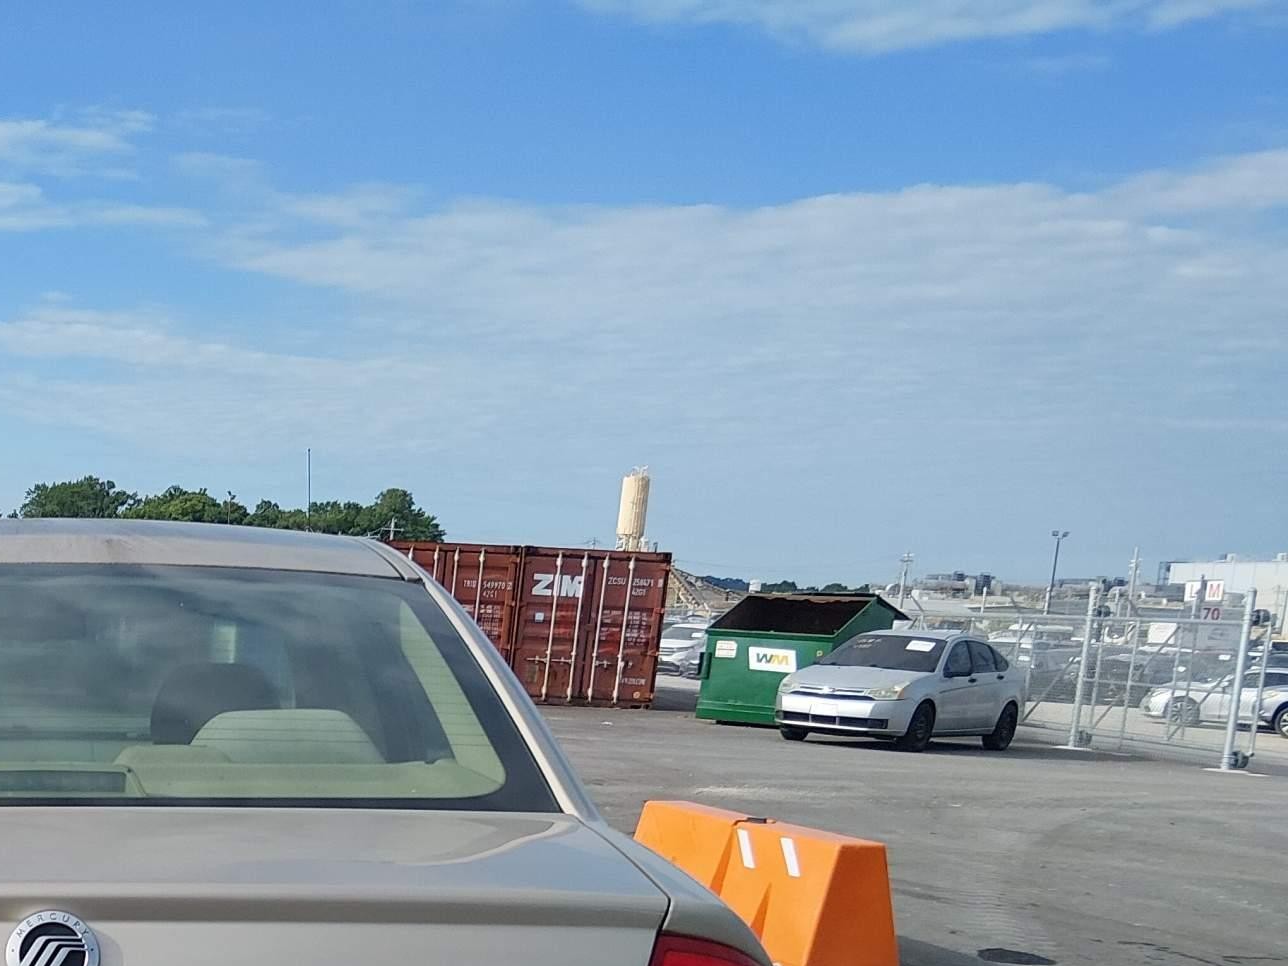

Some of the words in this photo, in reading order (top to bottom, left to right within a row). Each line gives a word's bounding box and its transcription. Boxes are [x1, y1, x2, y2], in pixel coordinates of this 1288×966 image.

[532, 573, 583, 597] ZIM
[607, 576, 627, 585] ZCSU
[1208, 584, 1221, 598] M
[1202, 607, 1221, 621] 70
[756, 653, 789, 666] WM
[16, 912, 89, 938] MERCURY
